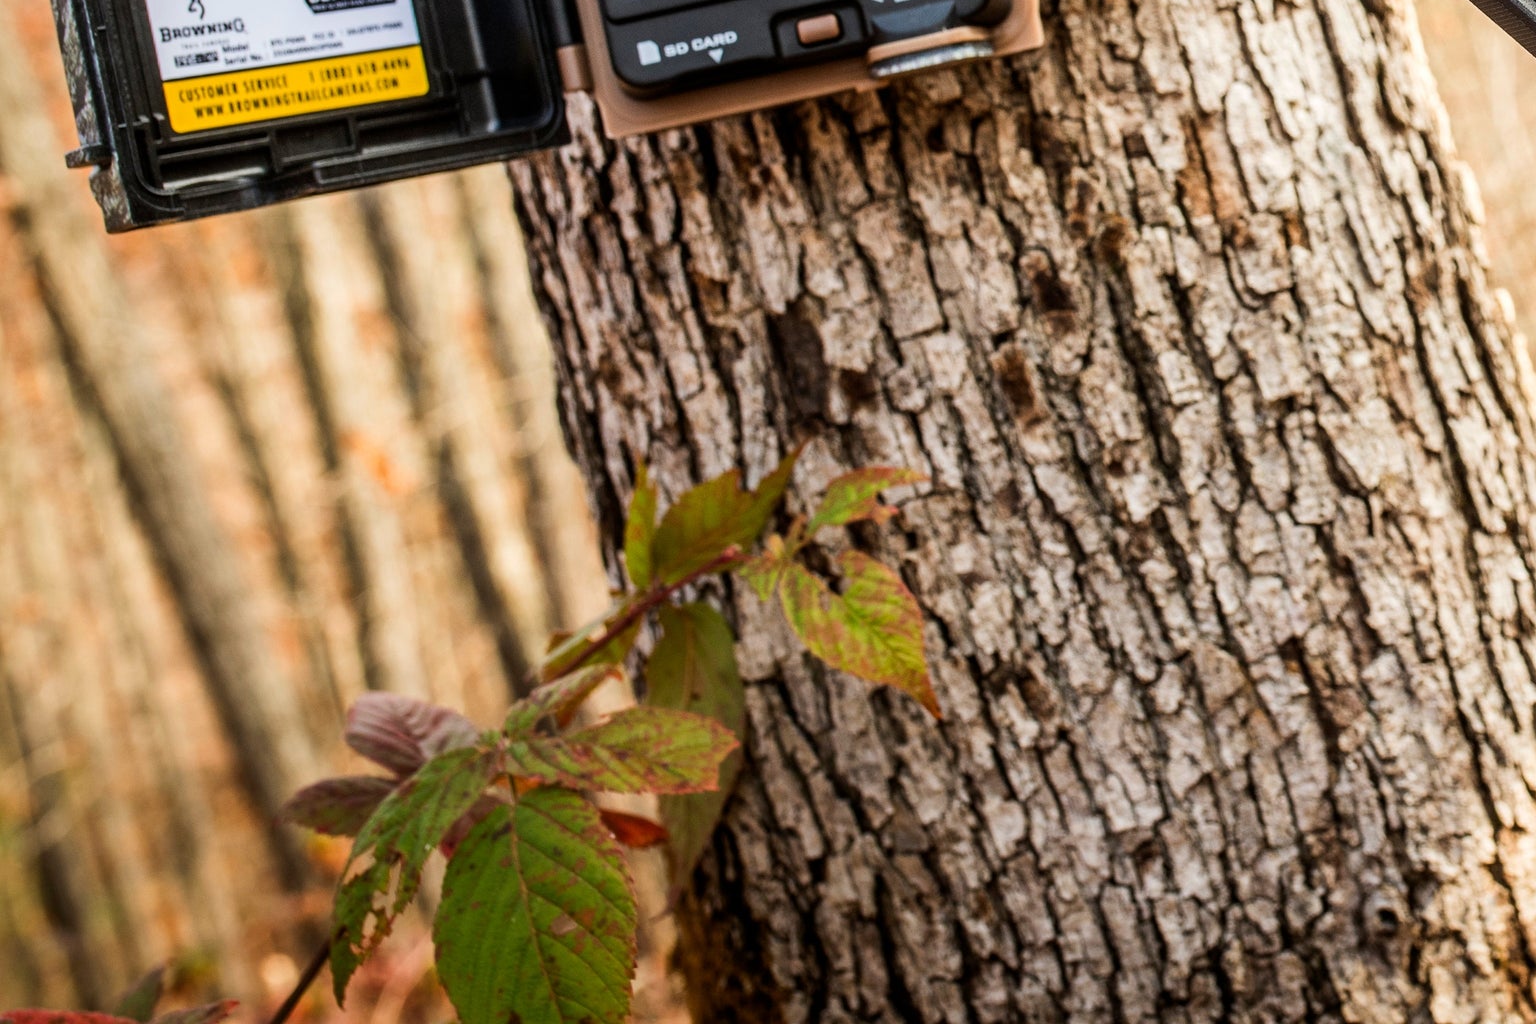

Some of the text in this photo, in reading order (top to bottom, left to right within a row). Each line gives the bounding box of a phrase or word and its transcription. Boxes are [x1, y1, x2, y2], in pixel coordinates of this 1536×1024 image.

[159, 18, 245, 43] BROWNING
[664, 30, 738, 57] SD CARD
[179, 82, 239, 103] CUSTOMER
[243, 75, 288, 95] SERVICE
